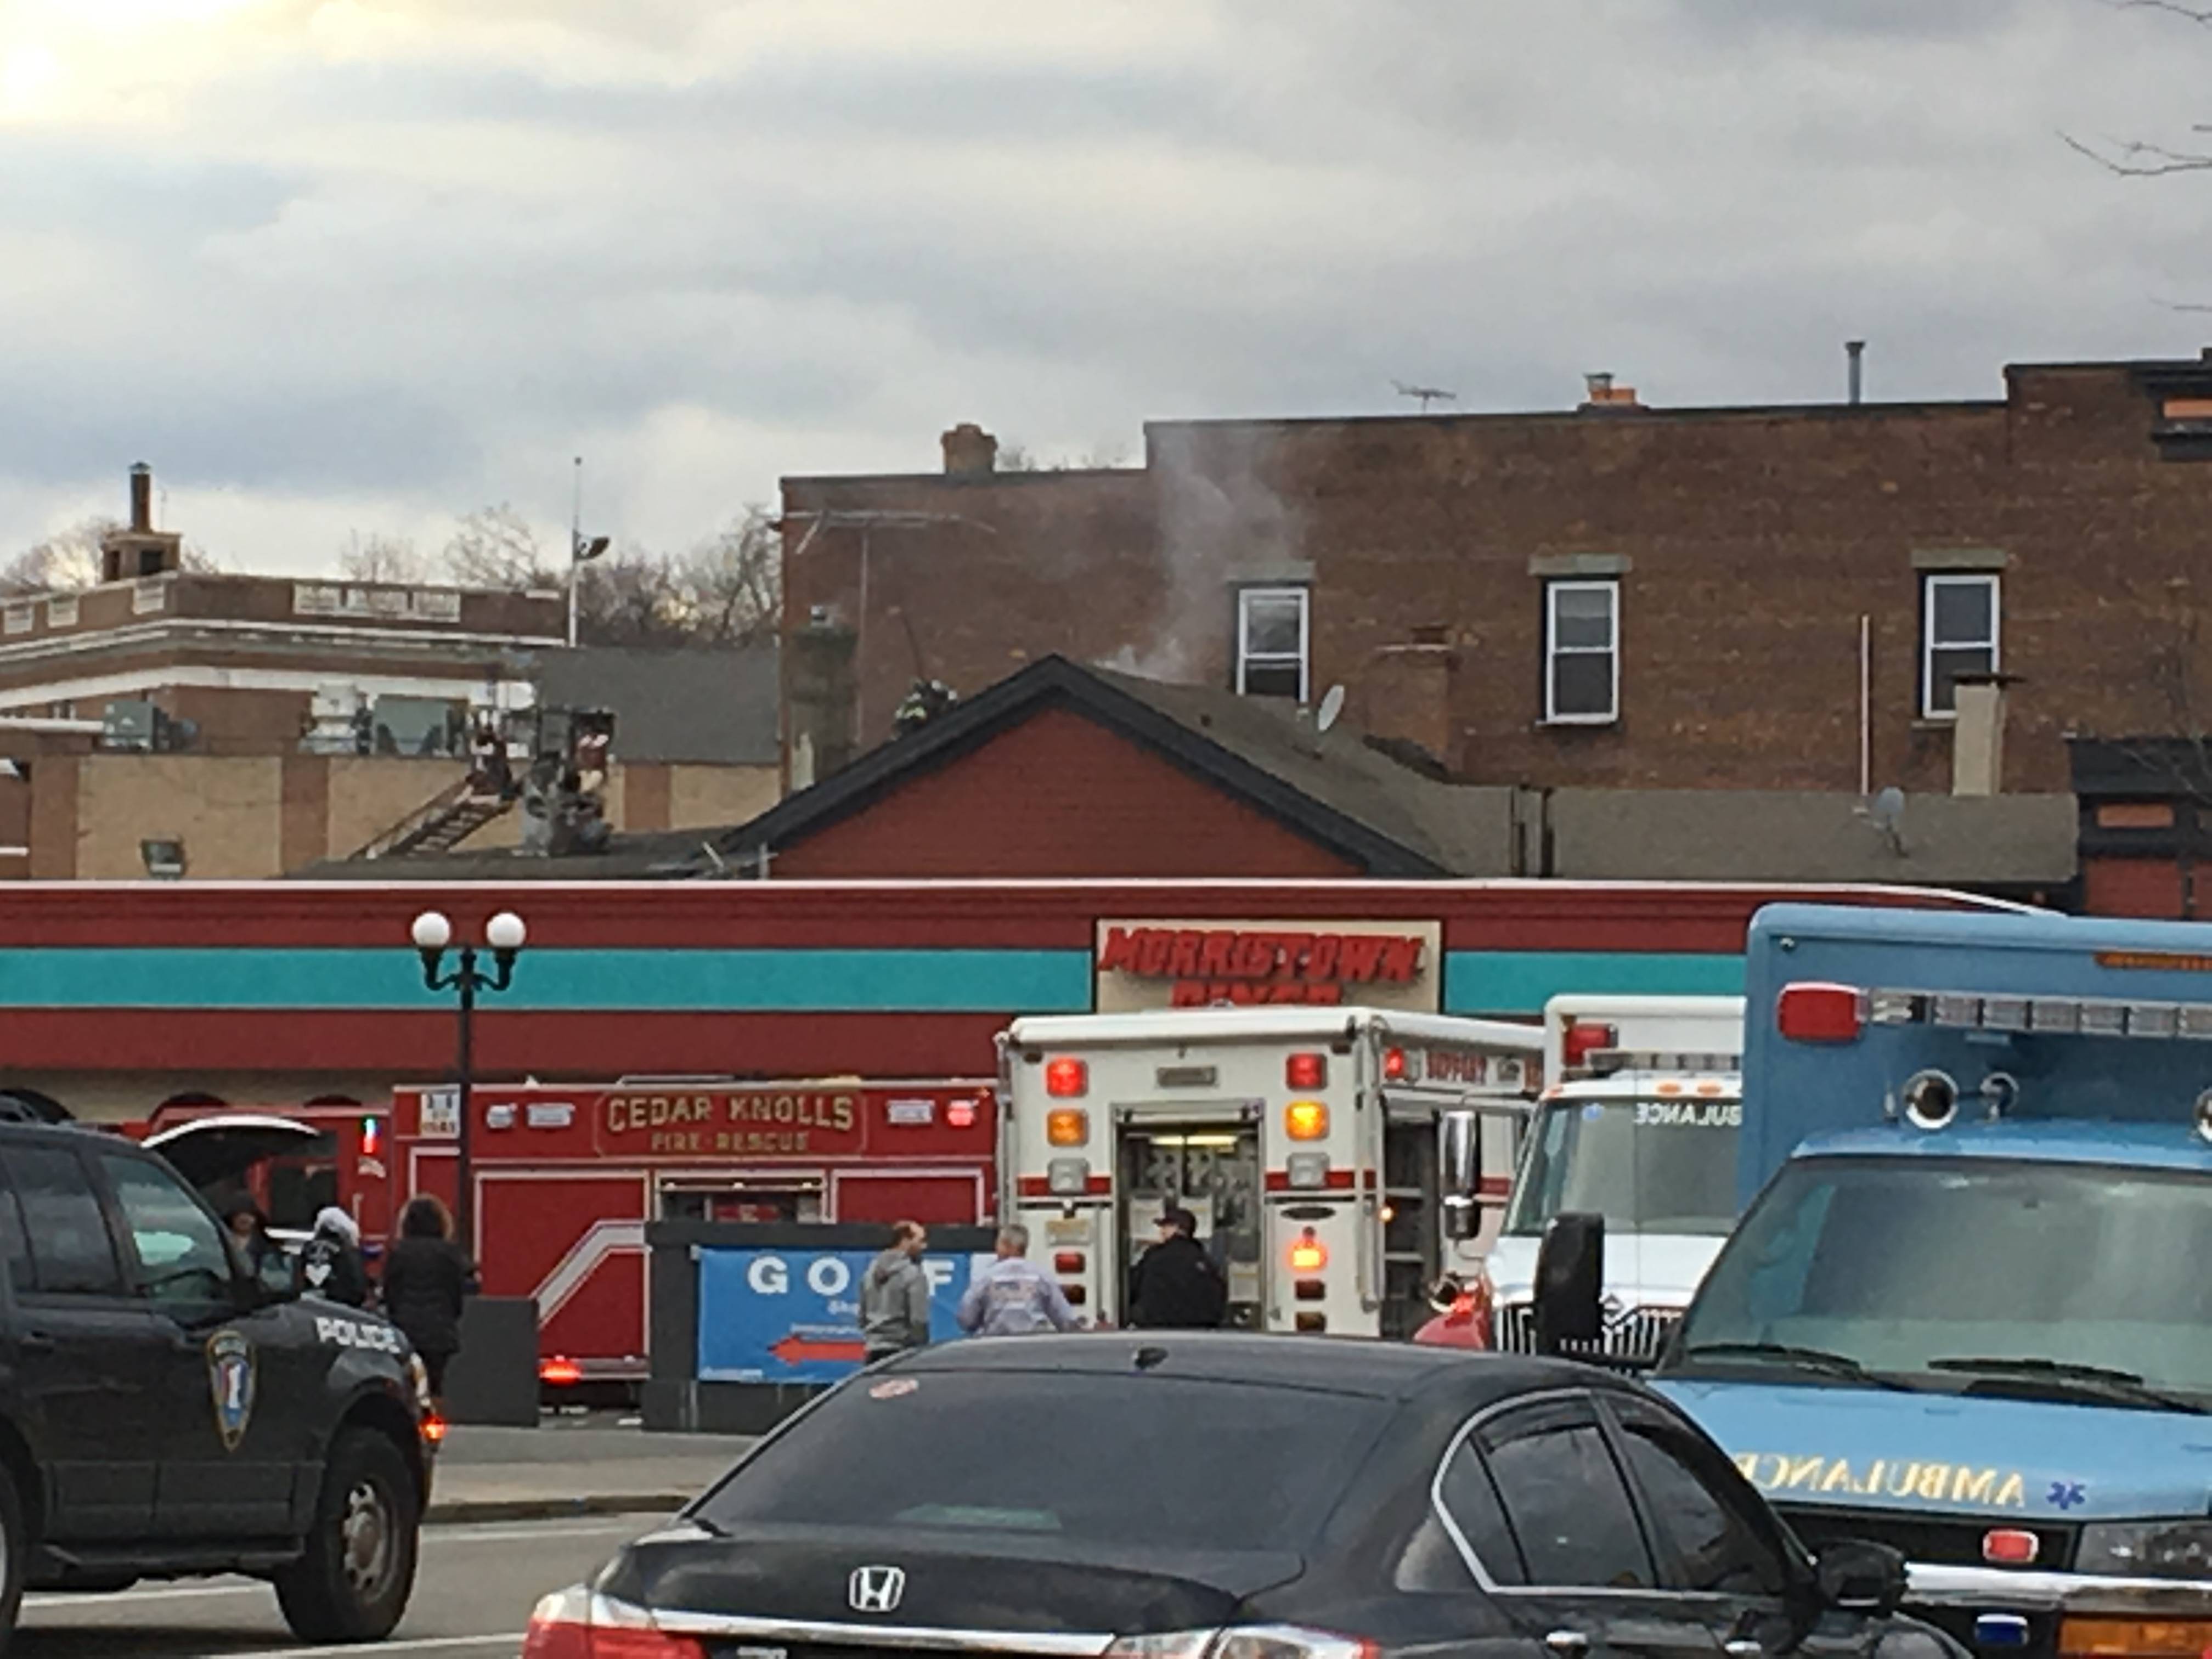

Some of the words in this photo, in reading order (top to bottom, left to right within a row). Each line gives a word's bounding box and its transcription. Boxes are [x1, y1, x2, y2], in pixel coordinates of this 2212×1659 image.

[1099, 927, 1425, 982] MORRISTOWN
[607, 1097, 712, 1132] CEDAR
[729, 1096, 854, 1131] KNOLLS
[651, 1132, 701, 1152] FIRE
[715, 1132, 810, 1152] RESCUE
[747, 1256, 955, 1296] GOF
[315, 1317, 401, 1354] POLICE
